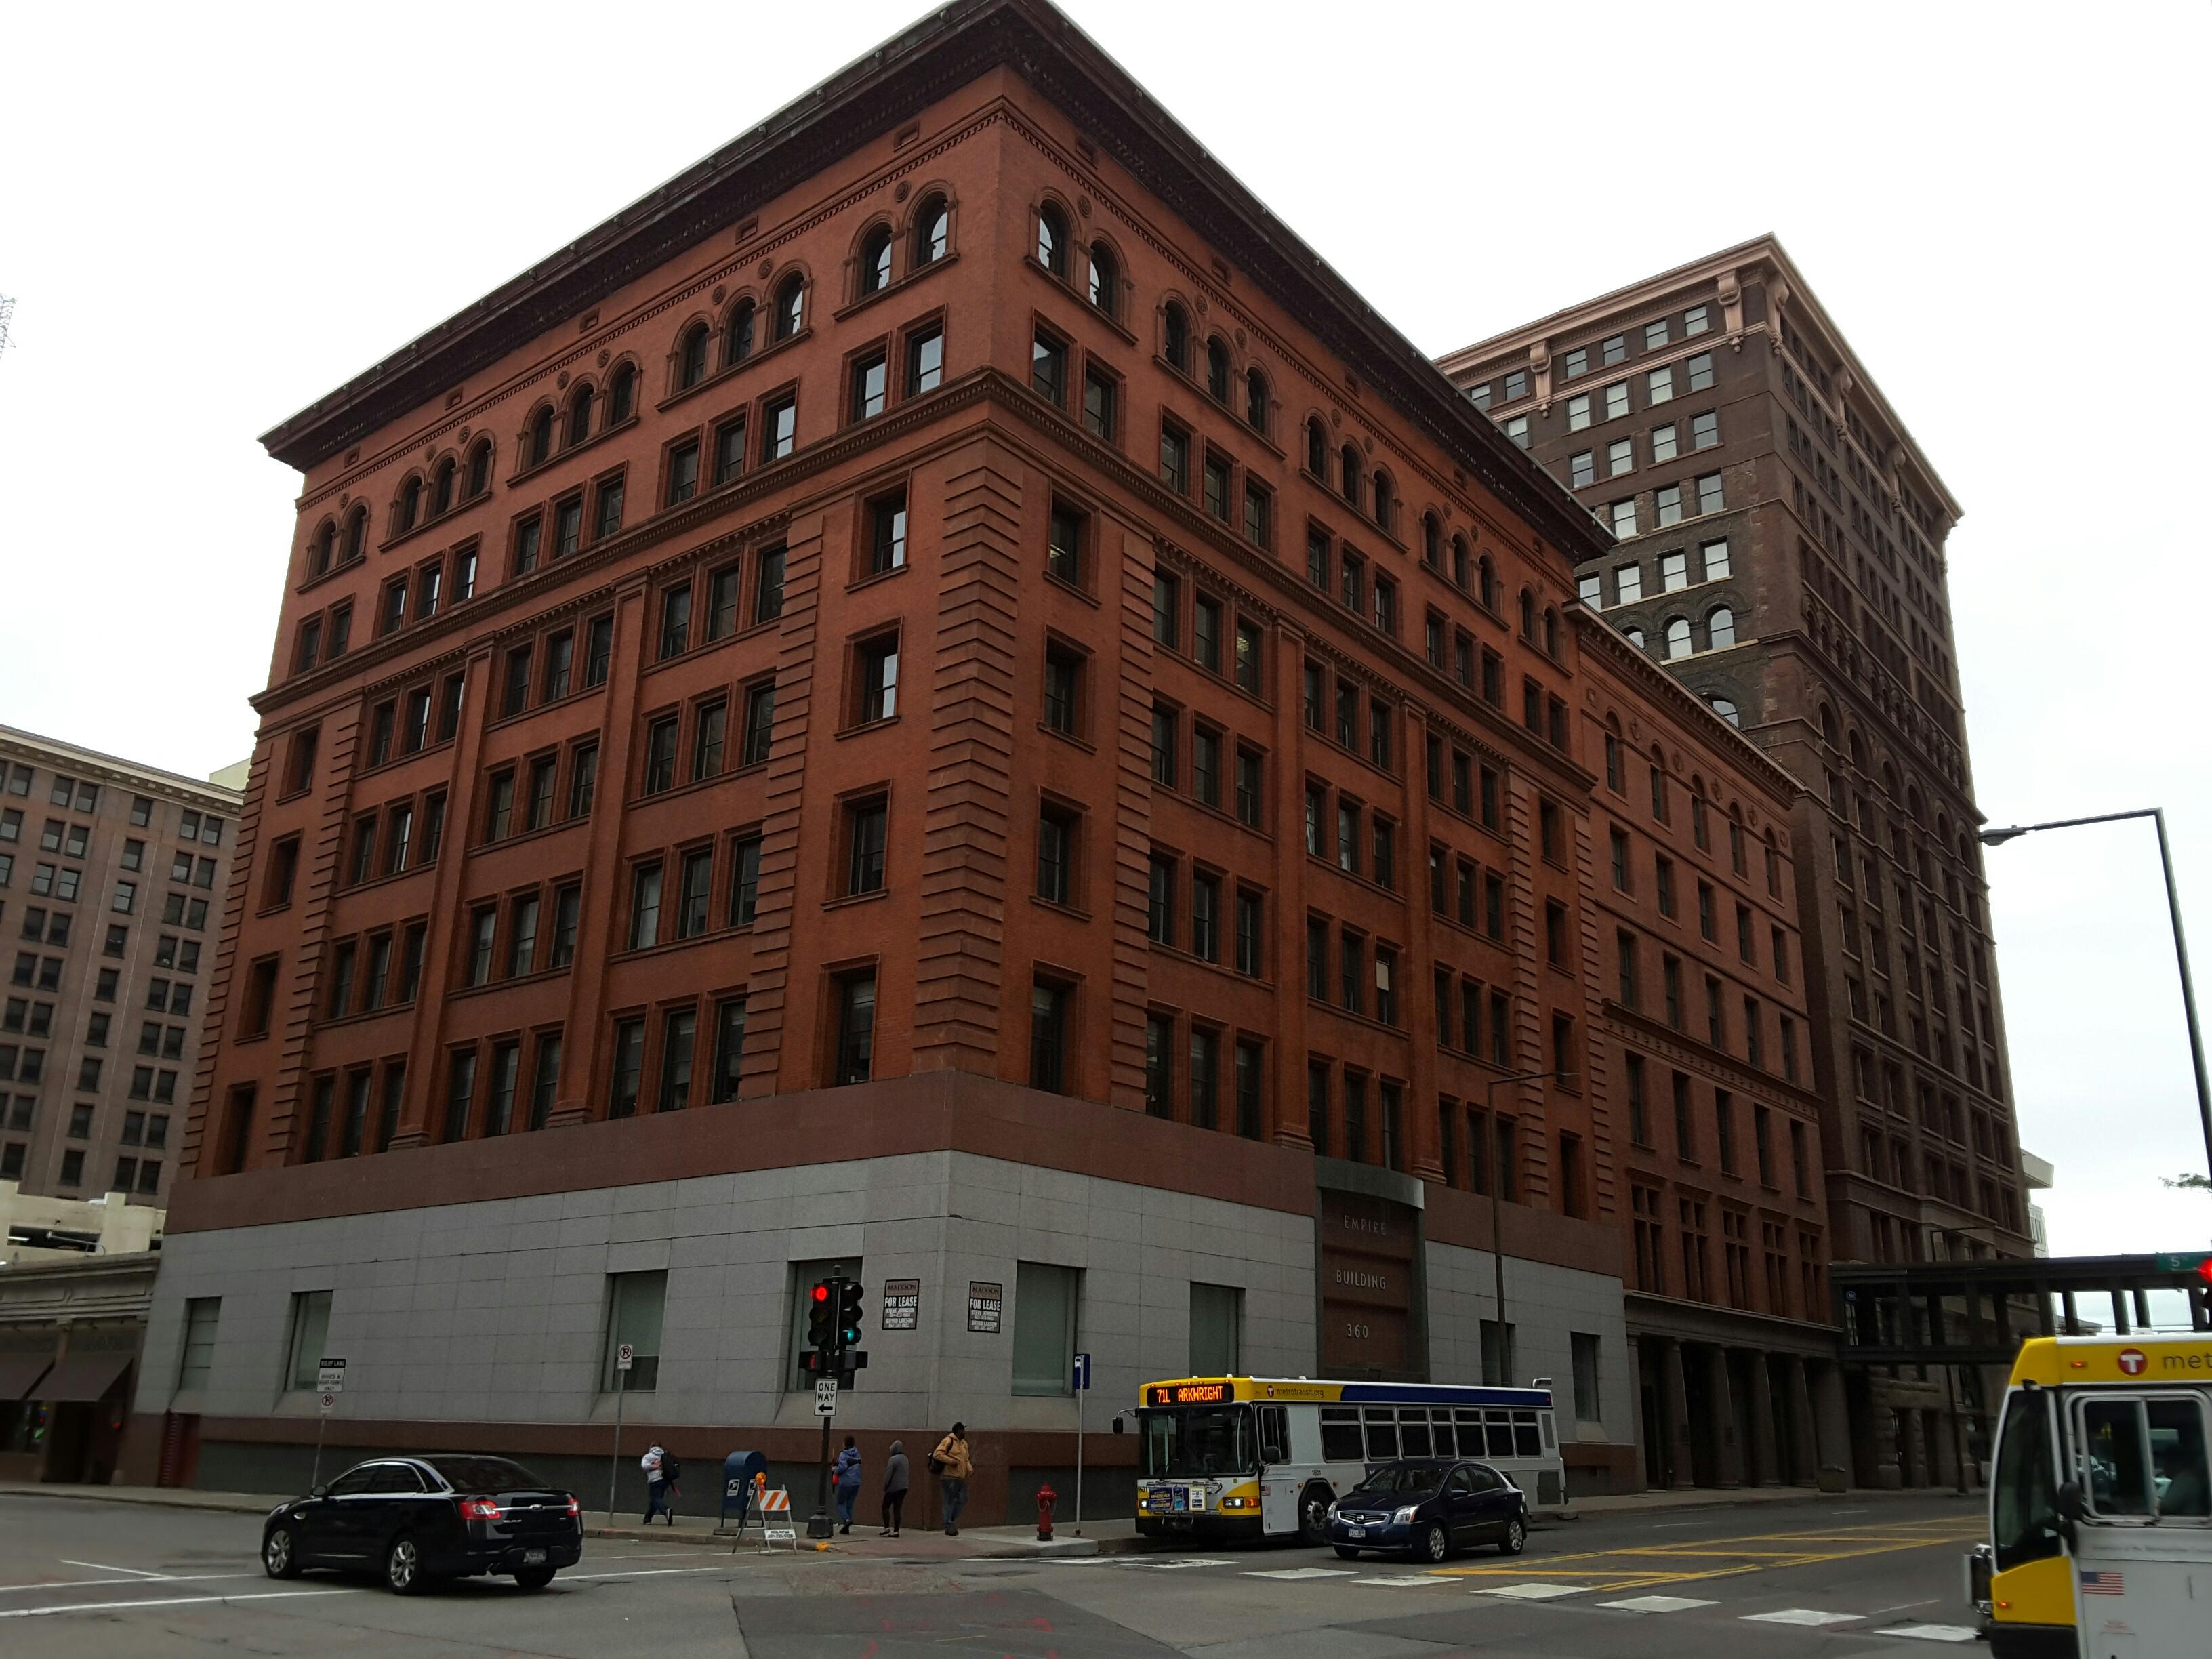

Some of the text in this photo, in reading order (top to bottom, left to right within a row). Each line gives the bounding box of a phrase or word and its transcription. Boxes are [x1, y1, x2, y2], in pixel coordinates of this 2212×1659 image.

[1343, 1214, 1387, 1236] EMPIRE
[1336, 1269, 1387, 1290] BUILDING
[884, 1296, 917, 1307] FOR LEASE
[970, 1298, 1000, 1311] FOR LEASE
[1346, 1323, 1368, 1339] 360
[818, 1382, 836, 1391] ONE
[817, 1393, 835, 1401] WAY
[1156, 1385, 1223, 1404] 71L ARKWRIGHT
[1277, 1388, 1324, 1399] metrotransit.org
